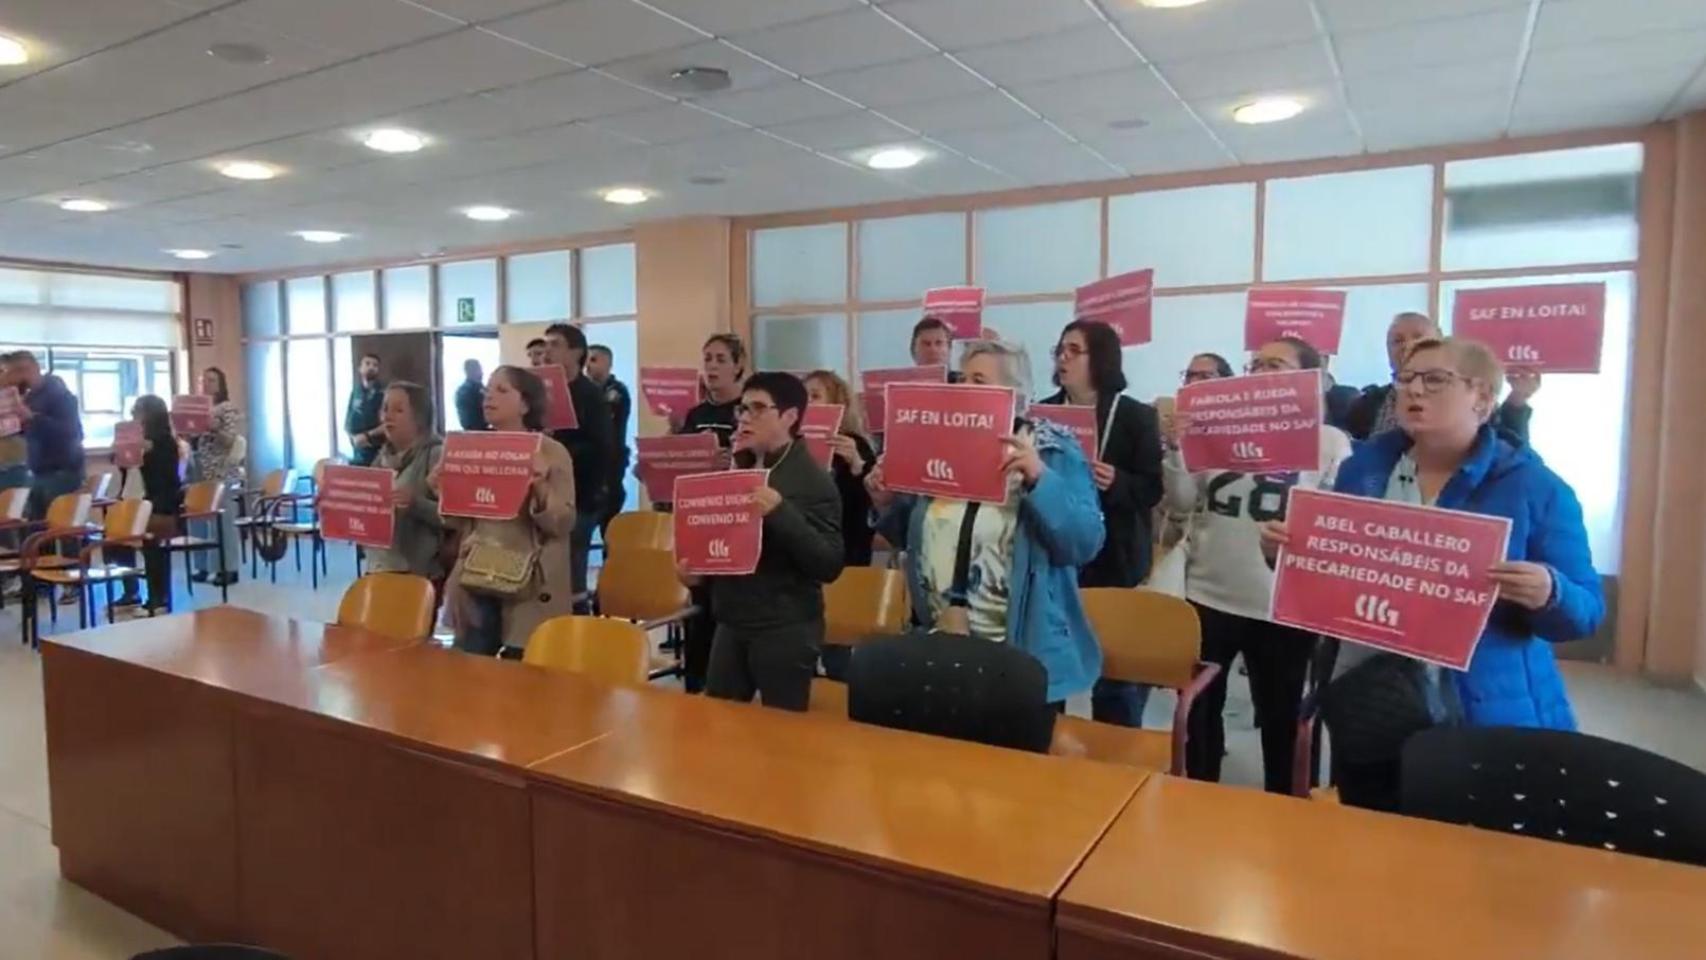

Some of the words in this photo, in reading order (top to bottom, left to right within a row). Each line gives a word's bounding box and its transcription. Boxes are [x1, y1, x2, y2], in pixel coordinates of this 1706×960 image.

[1469, 308, 1498, 321] SAF
[1501, 306, 1523, 319] EN
[1527, 304, 1586, 318] LOITA!
[1254, 387, 1297, 400] RUEDA
[1280, 403, 1301, 415] DA
[896, 409, 919, 424] SAF
[921, 410, 940, 425] EN
[943, 411, 994, 429] LOITA!
[1269, 421, 1290, 431] NO
[1294, 418, 1316, 430] SAF
[679, 496, 723, 508] CONVENIO
[688, 513, 733, 525] CONVENIO
[1314, 515, 1357, 534] ABEL
[1363, 522, 1471, 553] CABALLERO
[1306, 535, 1441, 572] RESPONSÁBEIS
[1445, 560, 1470, 578] DA
[1285, 554, 1416, 592] PRECARIEDADE
[1419, 579, 1450, 599] NO
[1454, 587, 1488, 606] SAF
